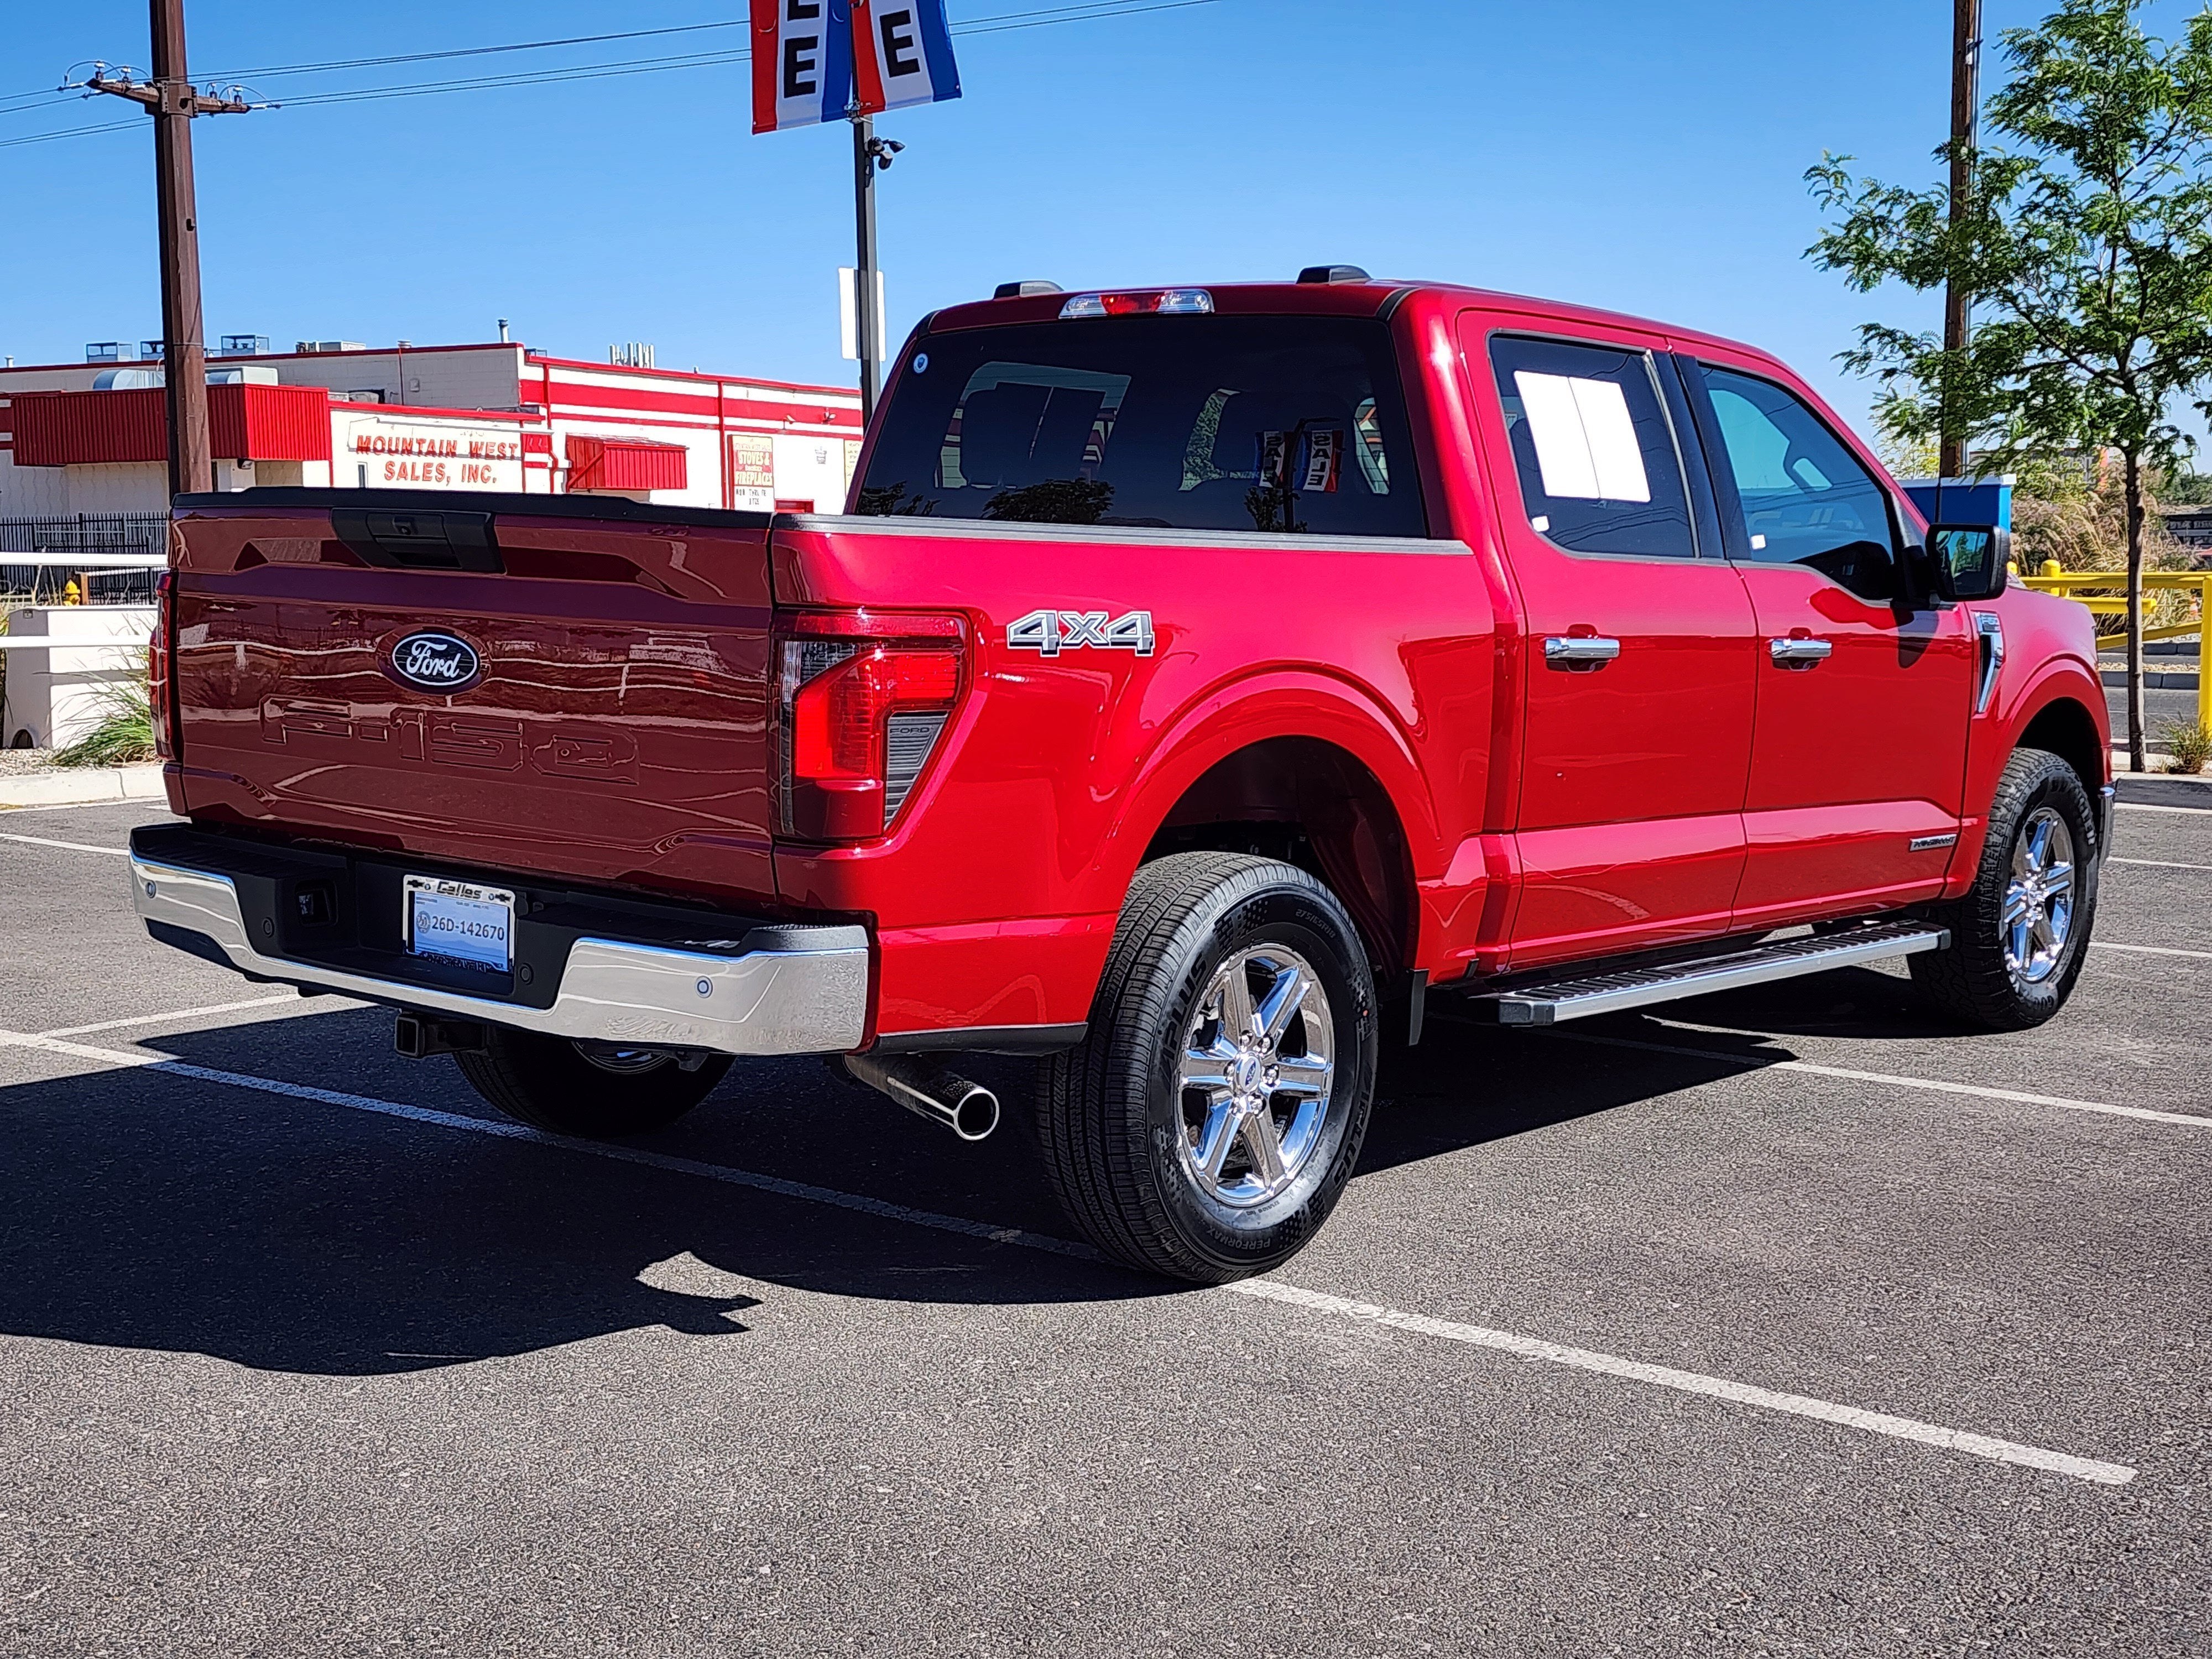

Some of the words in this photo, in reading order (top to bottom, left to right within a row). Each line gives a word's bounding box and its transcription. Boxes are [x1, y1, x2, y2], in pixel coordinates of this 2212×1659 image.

[356, 435, 457, 457] MOUNTAIN
[469, 441, 518, 460] WEST
[738, 450, 763, 465] STOVES
[384, 461, 451, 486] SALES,
[461, 464, 497, 483] INC.
[406, 640, 461, 678] Ford
[259, 693, 639, 785] F-150
[432, 916, 505, 941] 26D-142670
[1206, 1225, 1271, 1250] PERFORMAX
